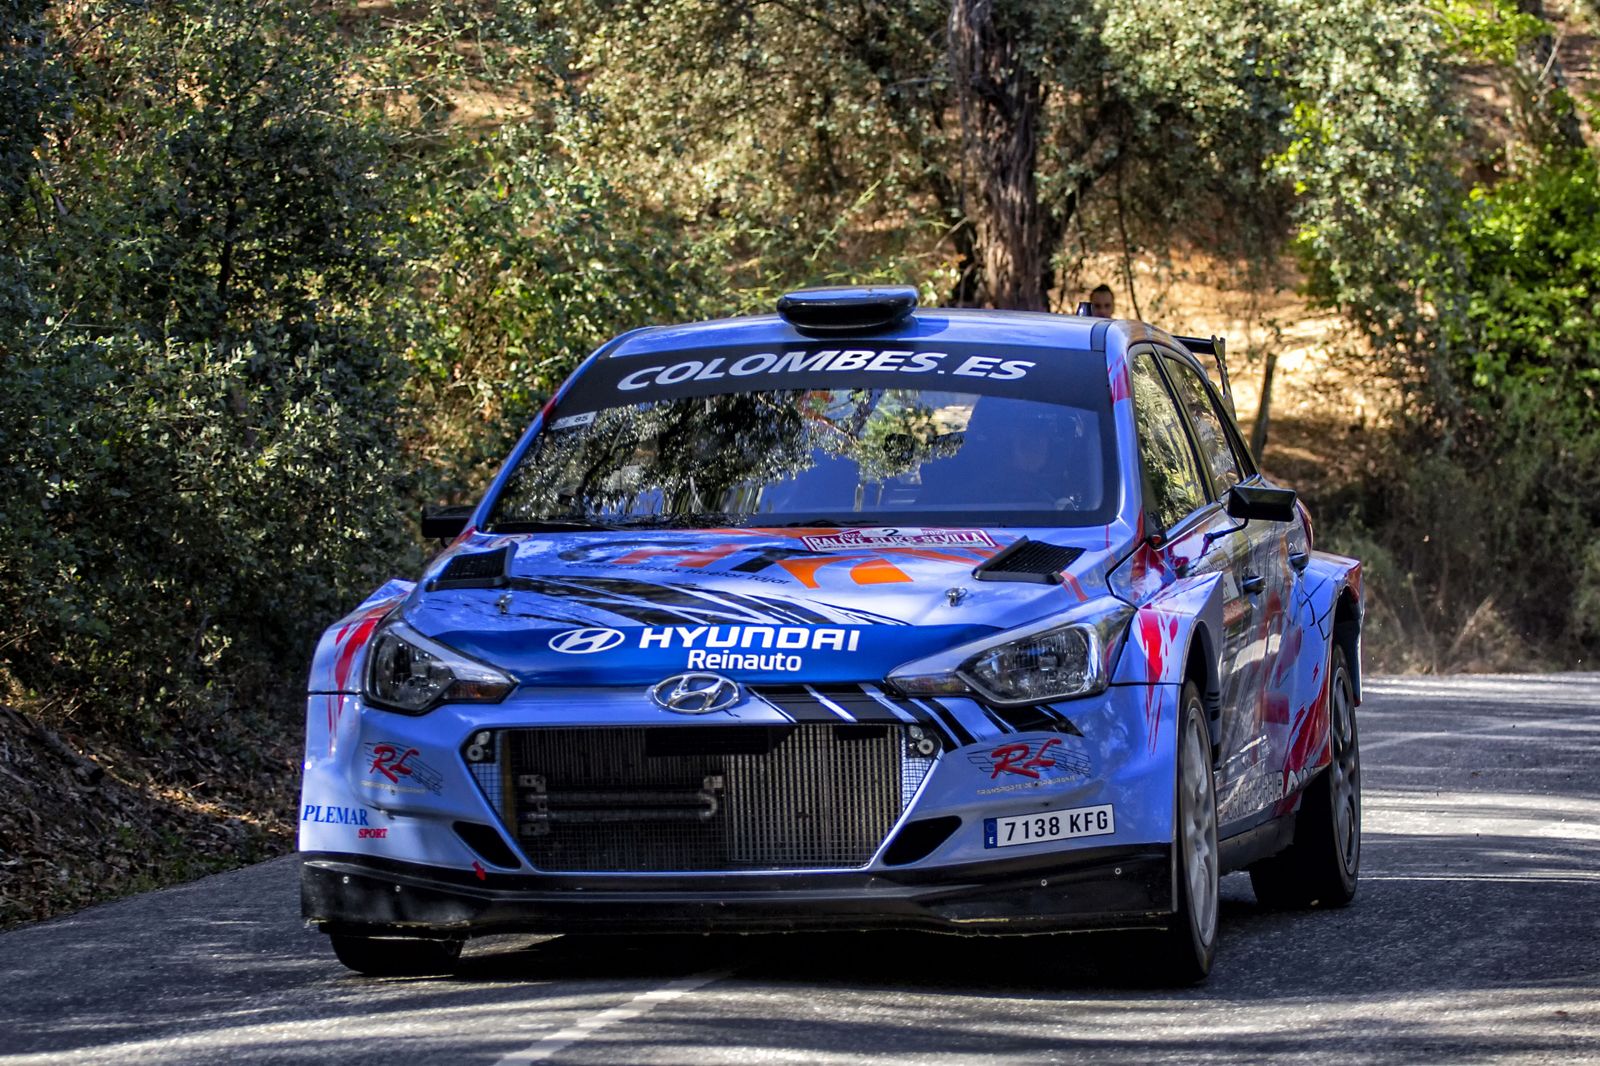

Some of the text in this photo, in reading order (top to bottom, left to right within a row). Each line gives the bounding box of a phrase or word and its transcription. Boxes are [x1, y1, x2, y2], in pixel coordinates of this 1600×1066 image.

[617, 350, 1036, 391] COLOMBES.ES
[808, 536, 867, 547] RALLYE
[882, 528, 902, 537] 2
[639, 626, 860, 652] HYUNDAI
[687, 649, 801, 671] Reinauto
[302, 804, 369, 826] PLEMAR
[1004, 810, 1108, 842] 7138 KFG
[358, 828, 388, 839] SPORT
[988, 836, 994, 845] E
